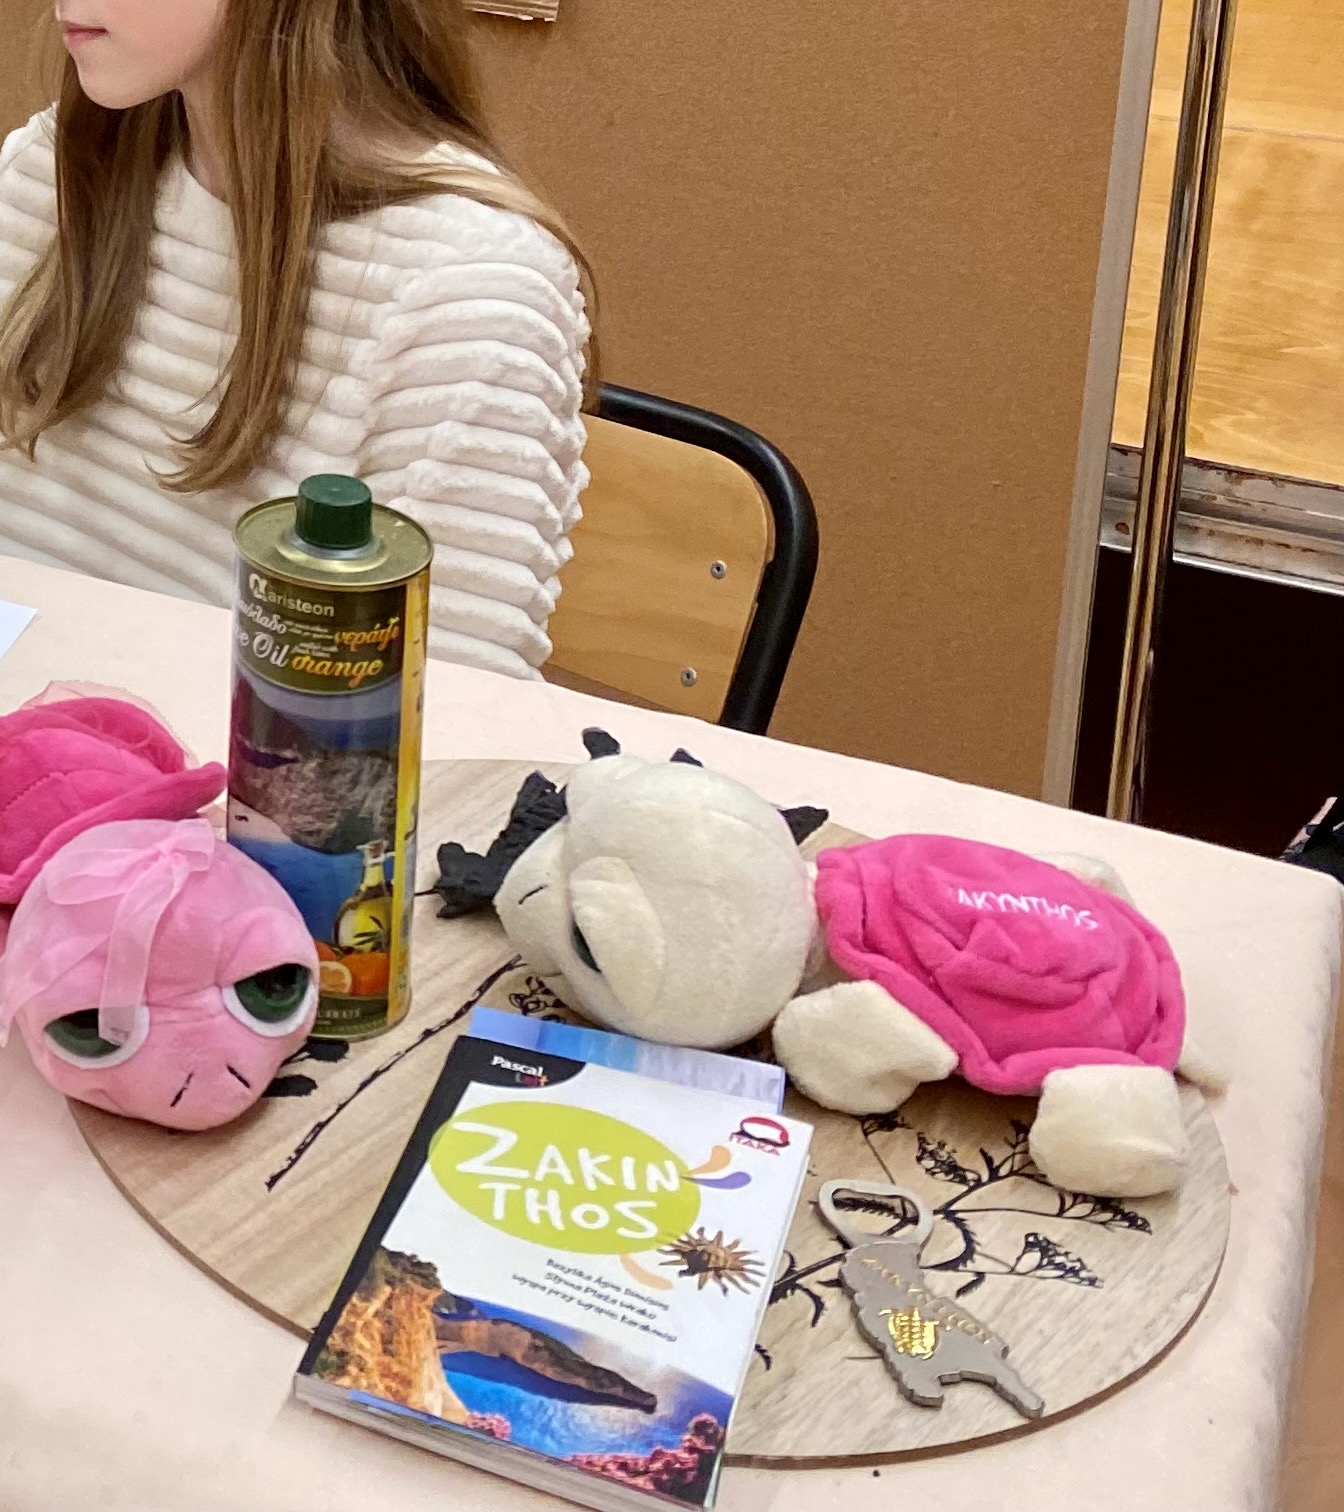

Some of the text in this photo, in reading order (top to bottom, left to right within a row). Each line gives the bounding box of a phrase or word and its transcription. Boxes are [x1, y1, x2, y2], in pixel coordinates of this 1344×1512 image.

[268, 592, 335, 617] aristeon
[253, 630, 290, 668] Oil
[291, 655, 384, 689] orange
[947, 887, 1099, 930] AKYNTHOS
[491, 1054, 544, 1077] Pascal
[451, 1121, 682, 1193] ZAKIN
[729, 1132, 781, 1156] ITAKA
[478, 1182, 659, 1240] THOS
